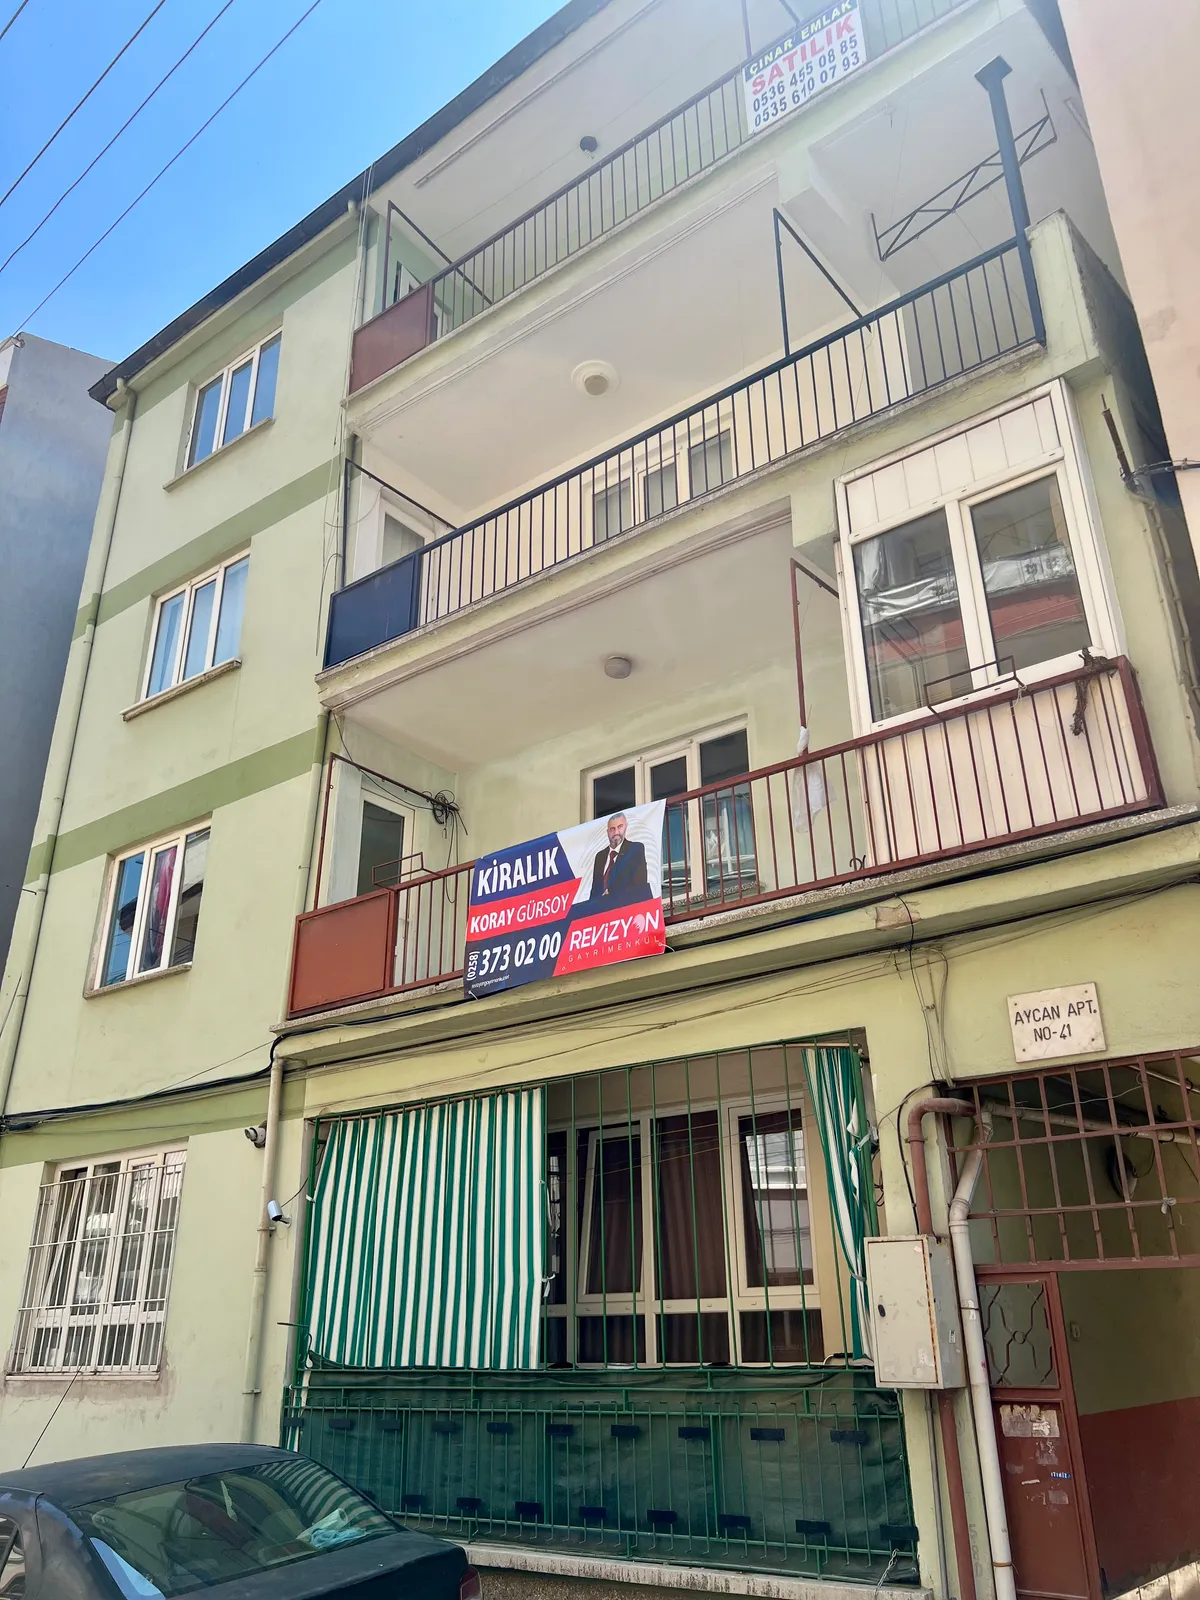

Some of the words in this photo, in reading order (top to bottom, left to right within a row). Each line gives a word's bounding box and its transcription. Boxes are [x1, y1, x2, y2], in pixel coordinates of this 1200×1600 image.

[749, 39, 793, 76] ÇINAR
[801, 0, 851, 40] EMLAK
[752, 13, 854, 96] SATILIK
[753, 80, 785, 112] 0536
[790, 61, 813, 87] 455
[819, 48, 835, 68] 08
[840, 34, 857, 55] 85
[755, 96, 787, 127] 0535
[792, 77, 814, 105] 610
[820, 64, 836, 84] 07
[842, 51, 860, 72] 93
[477, 846, 559, 897] KİRALIK
[470, 907, 515, 933] KORAY
[516, 893, 569, 922] GÜRSOY
[466, 951, 480, 980] (0258)
[478, 944, 511, 976] 373
[514, 938, 536, 967] 02
[538, 931, 561, 961] 00
[1014, 1005, 1060, 1025] AYCAN
[1033, 1023, 1072, 1042] NO-41
